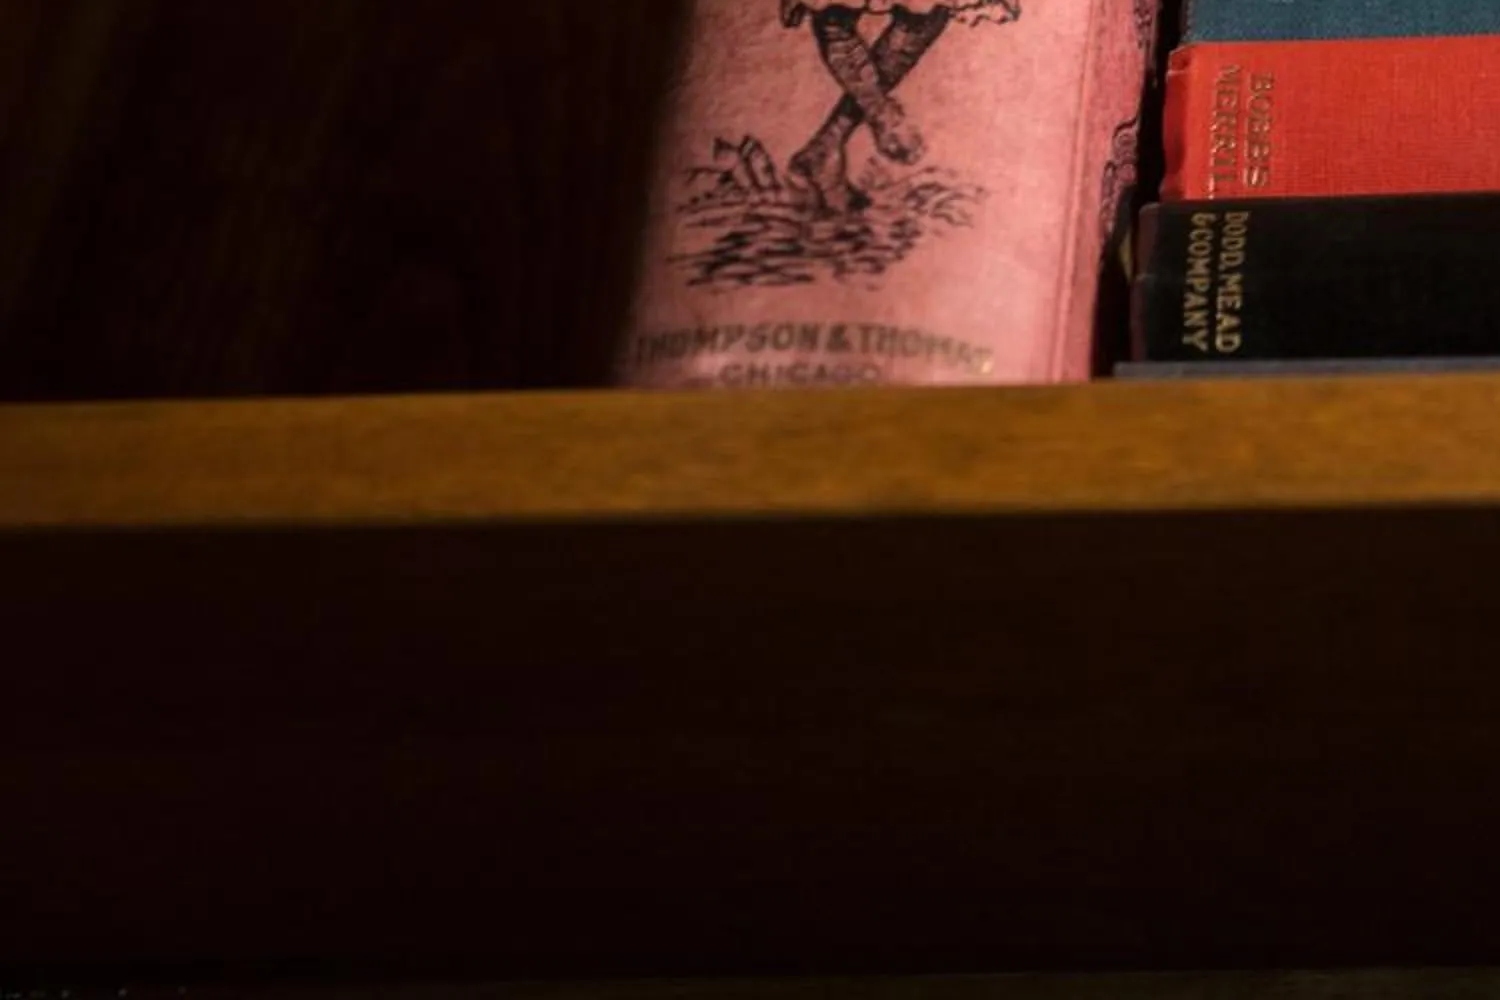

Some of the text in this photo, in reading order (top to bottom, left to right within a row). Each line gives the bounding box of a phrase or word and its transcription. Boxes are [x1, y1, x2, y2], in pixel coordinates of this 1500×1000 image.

[1242, 71, 1274, 188] BOBBS
[1214, 273, 1243, 353] MEAD
[719, 362, 881, 387] CHICAGO
